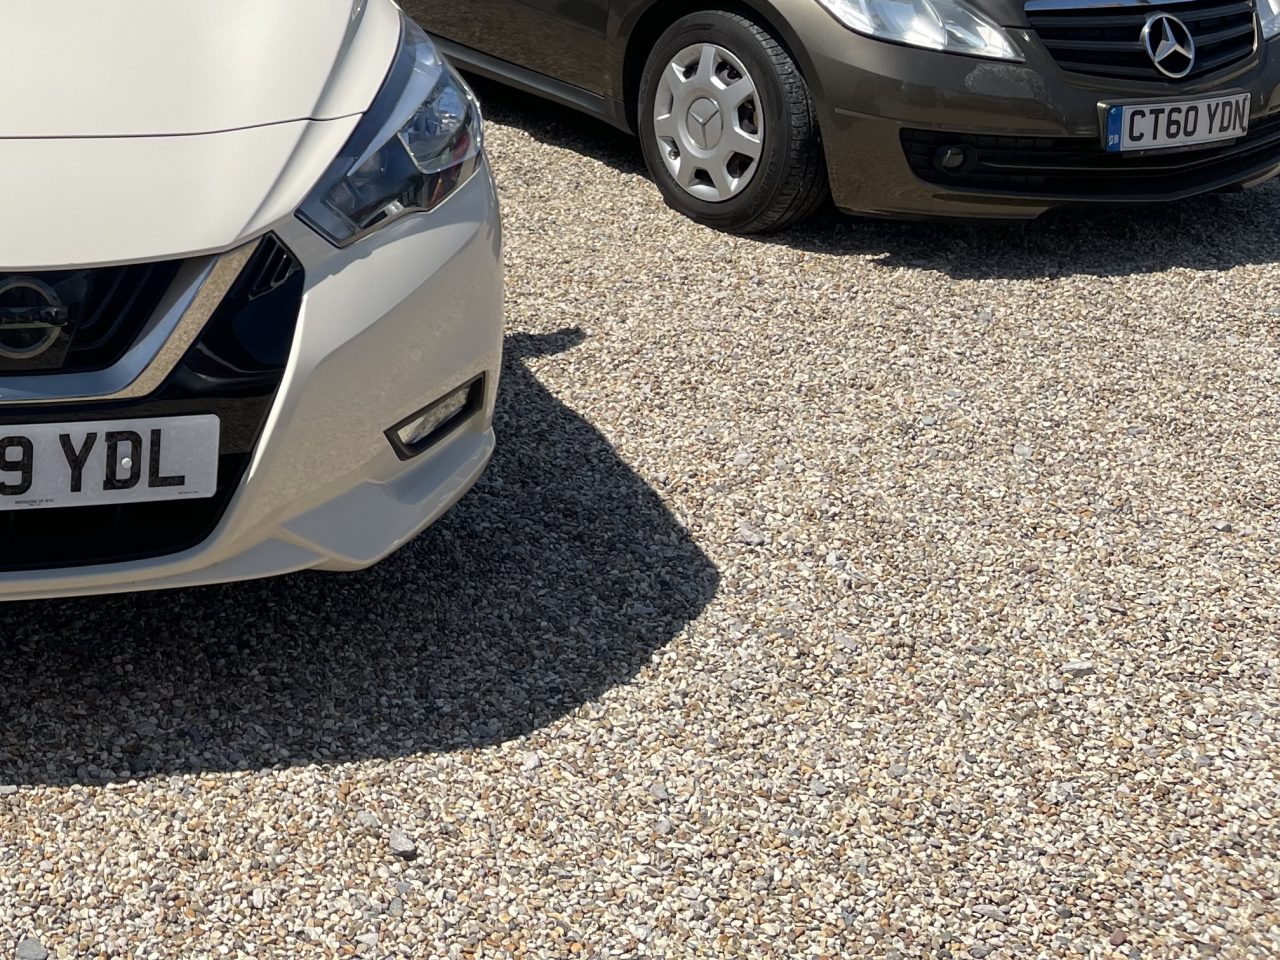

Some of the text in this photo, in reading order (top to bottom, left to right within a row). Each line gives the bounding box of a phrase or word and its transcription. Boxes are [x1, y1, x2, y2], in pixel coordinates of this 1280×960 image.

[1128, 98, 1247, 142] CT60 YDN
[58, 428, 186, 494] YDL
